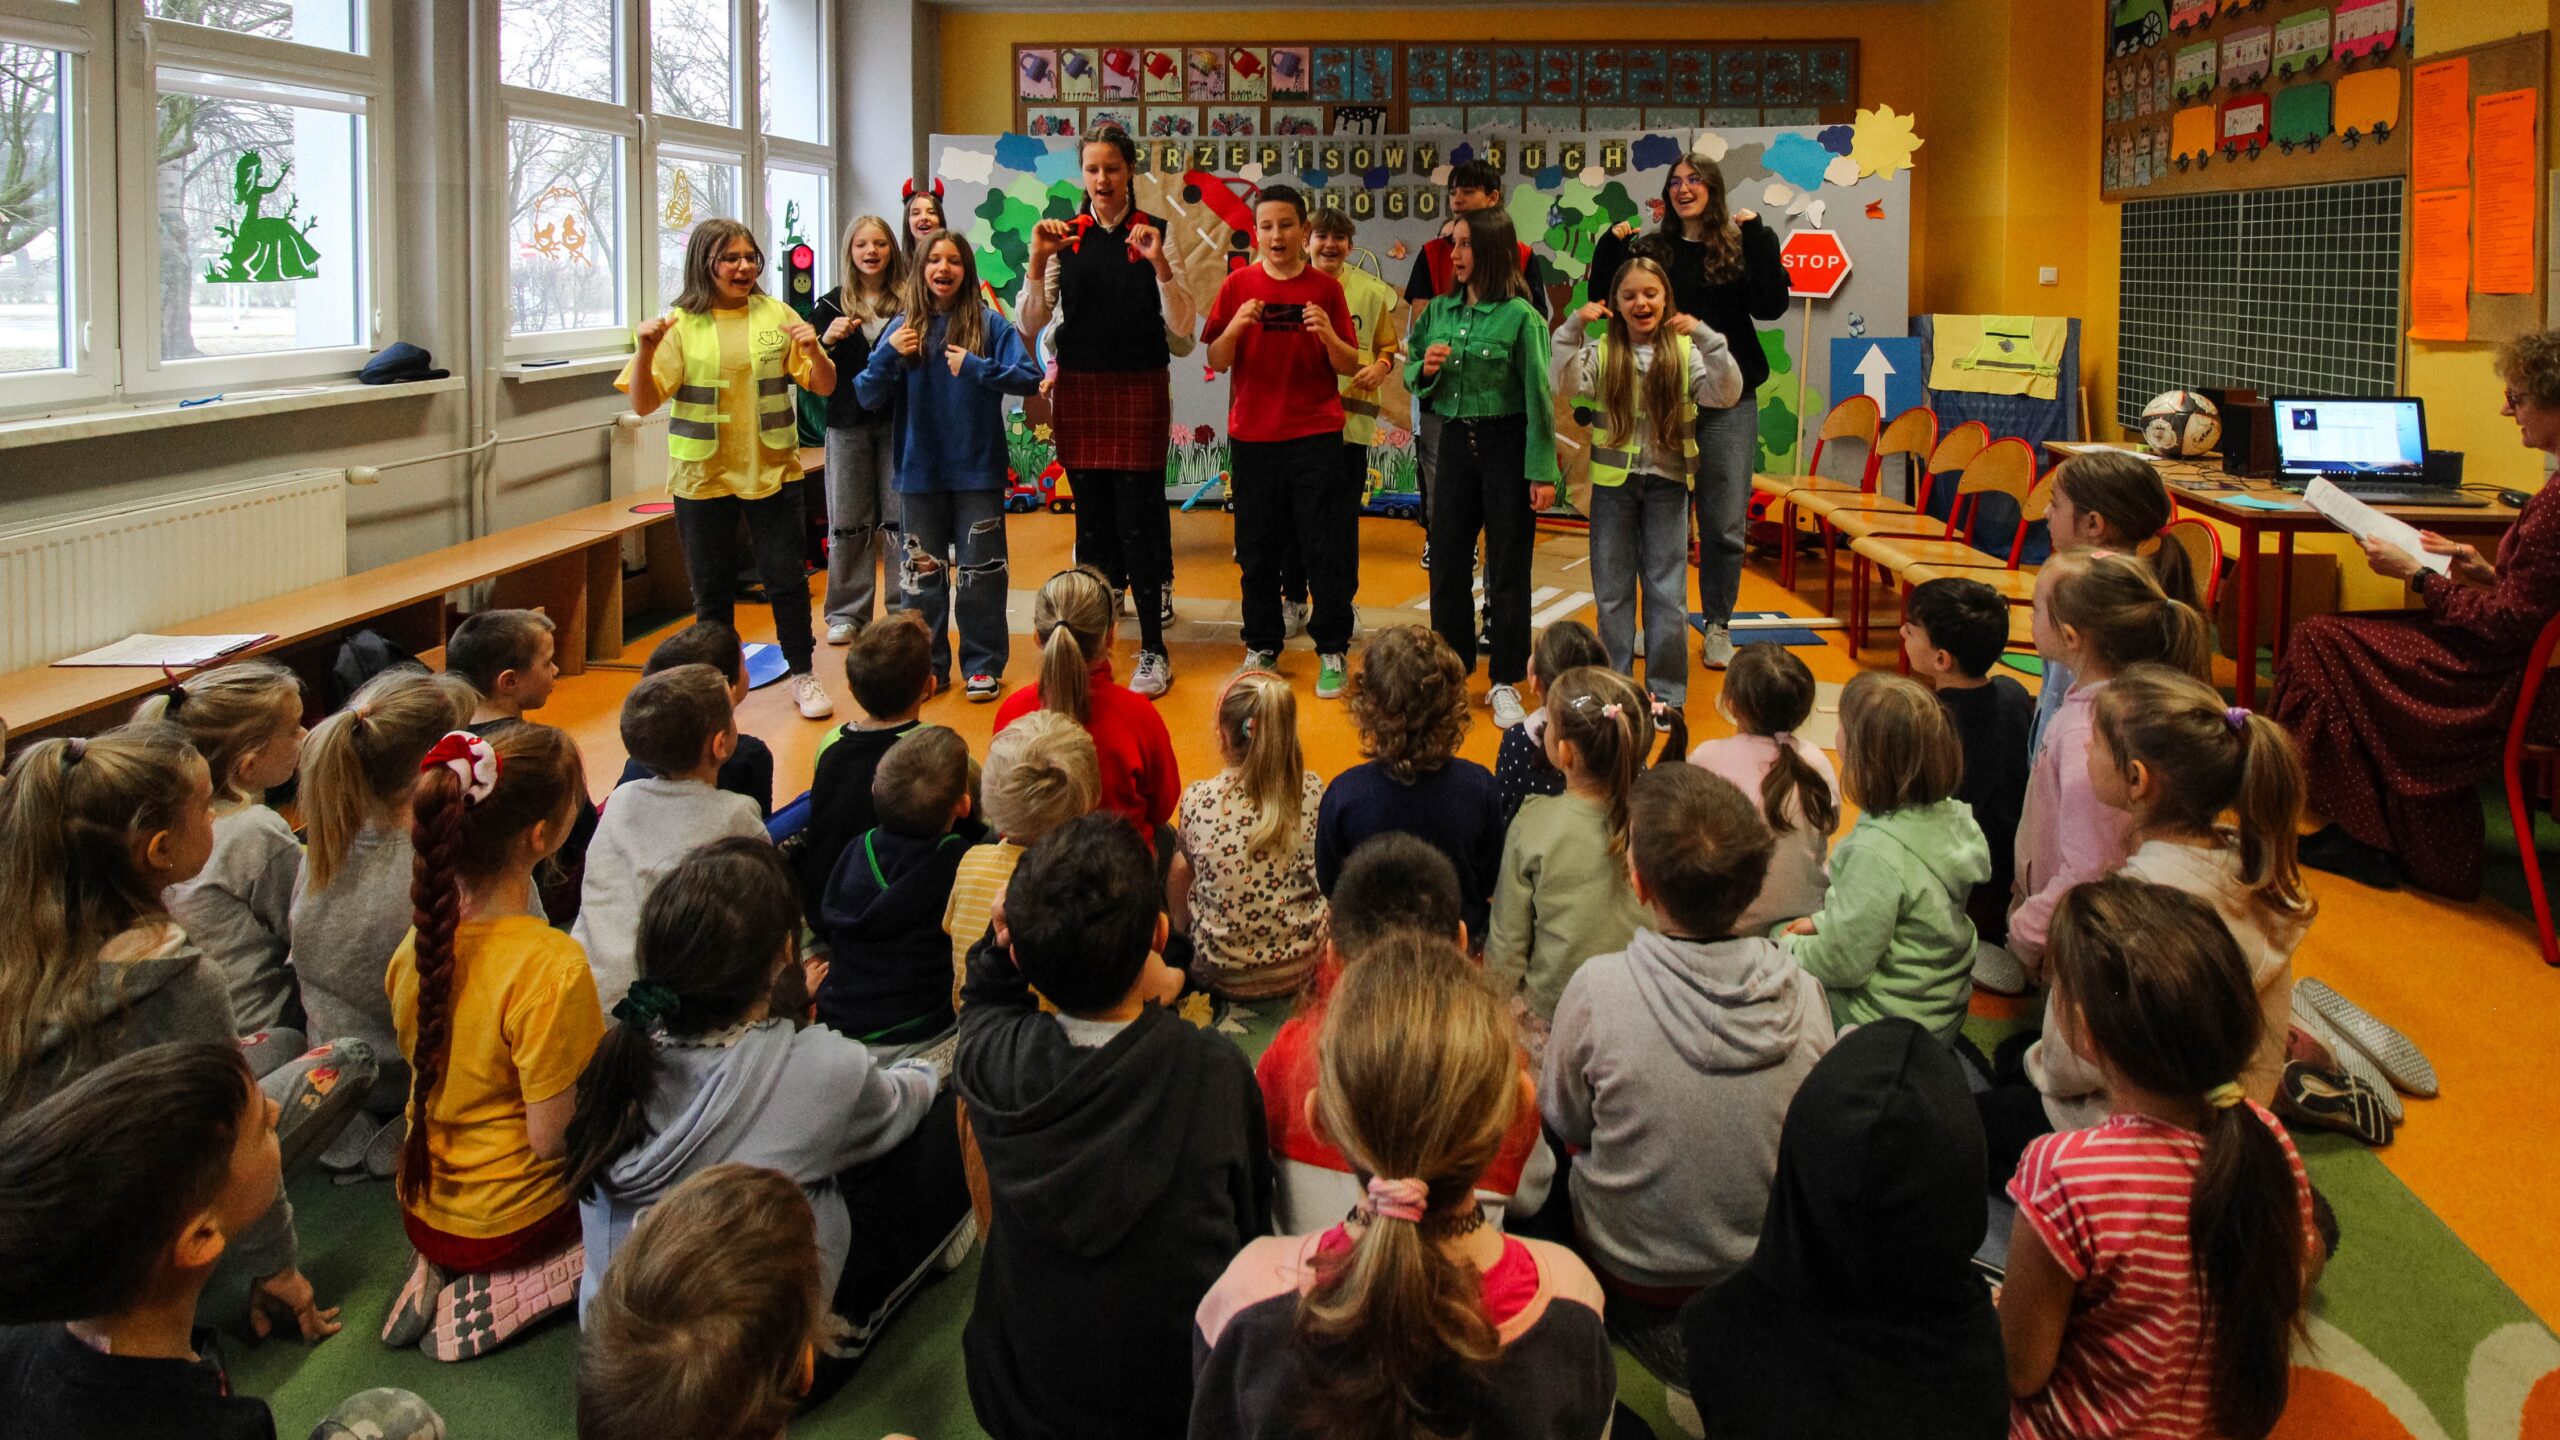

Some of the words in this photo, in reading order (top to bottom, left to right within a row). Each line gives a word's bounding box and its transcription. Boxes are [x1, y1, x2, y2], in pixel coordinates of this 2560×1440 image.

[1135, 147, 1434, 170] PRZEPISOWY
[1487, 147, 1621, 170] RUCH
[1782, 254, 1840, 269] STOP
